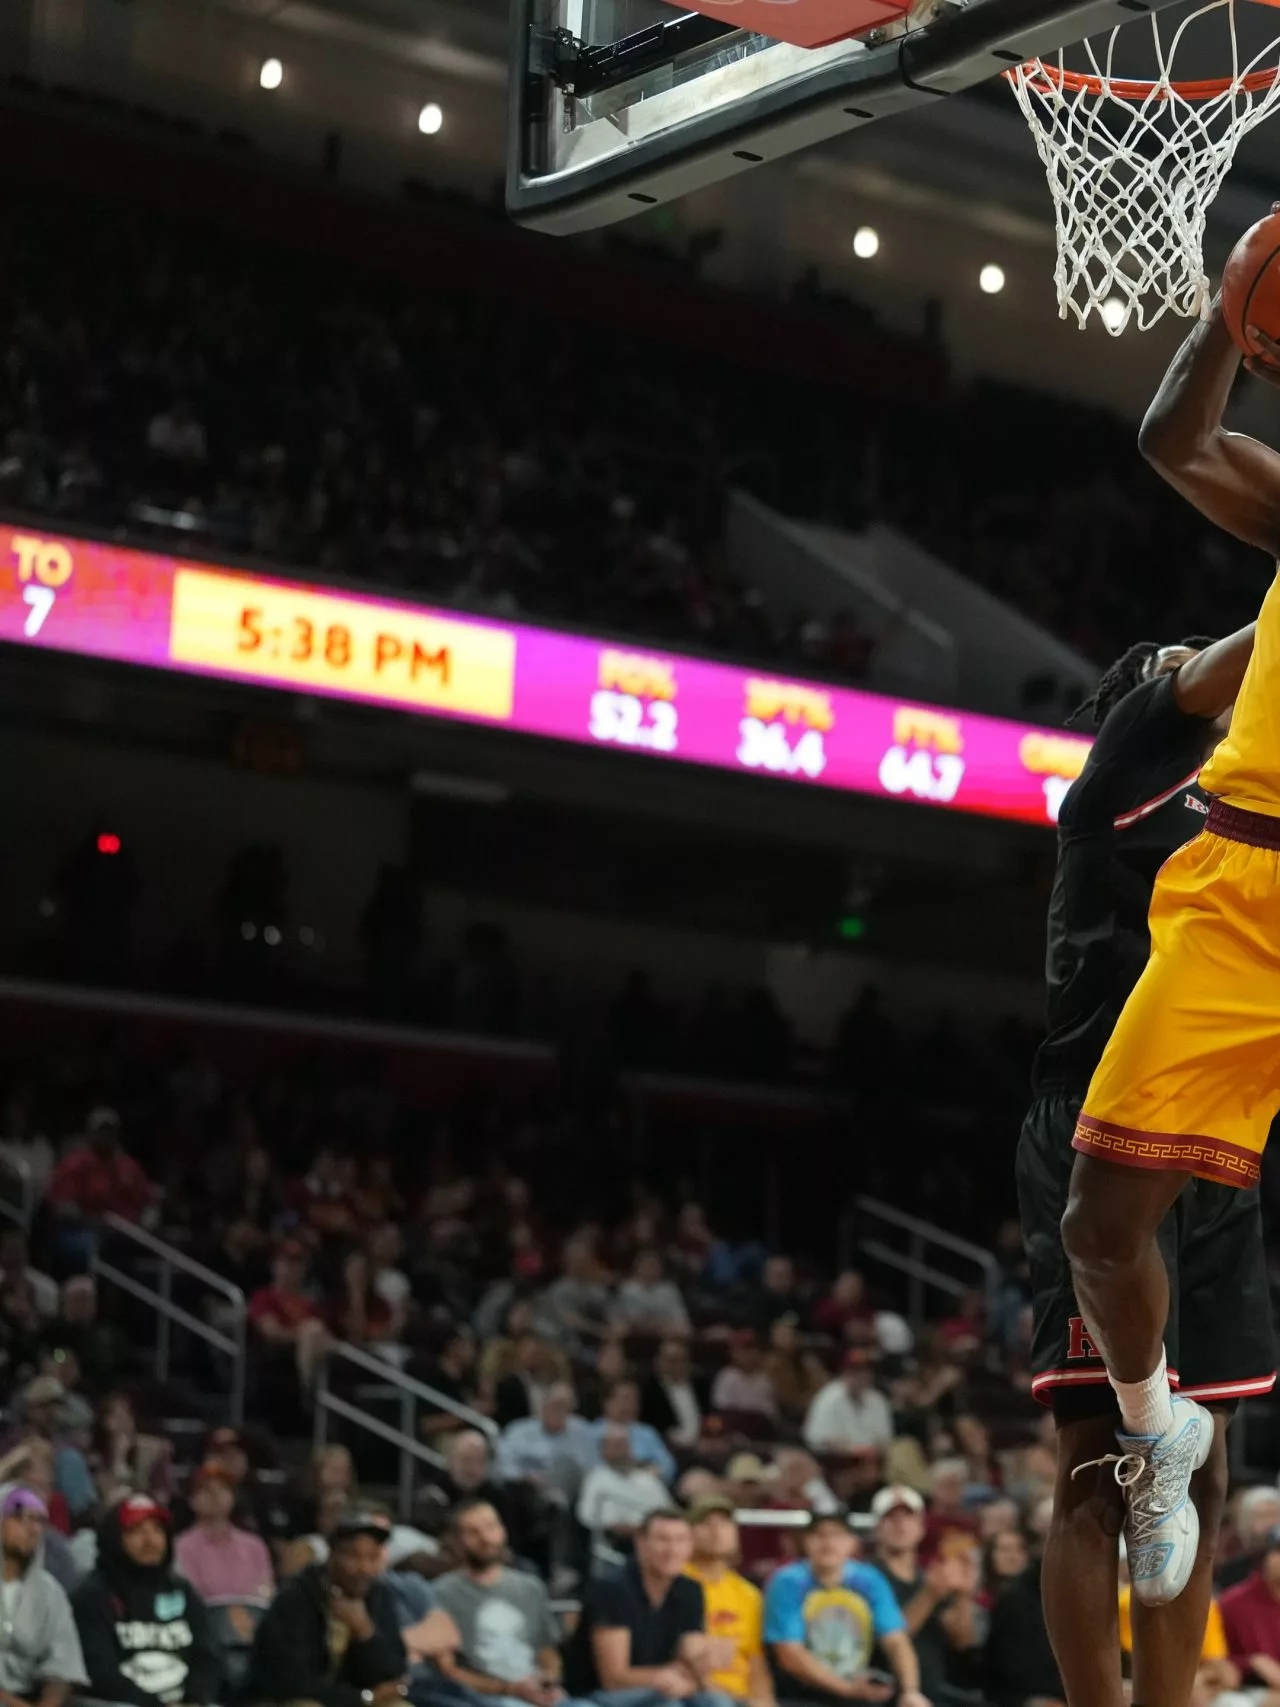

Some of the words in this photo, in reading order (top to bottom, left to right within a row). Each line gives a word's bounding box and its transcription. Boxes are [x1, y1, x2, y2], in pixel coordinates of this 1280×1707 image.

[11, 534, 73, 587] TO
[23, 583, 56, 638] 7
[237, 608, 352, 671] 5:38
[374, 632, 450, 687] PM
[878, 744, 966, 803] 64.7
